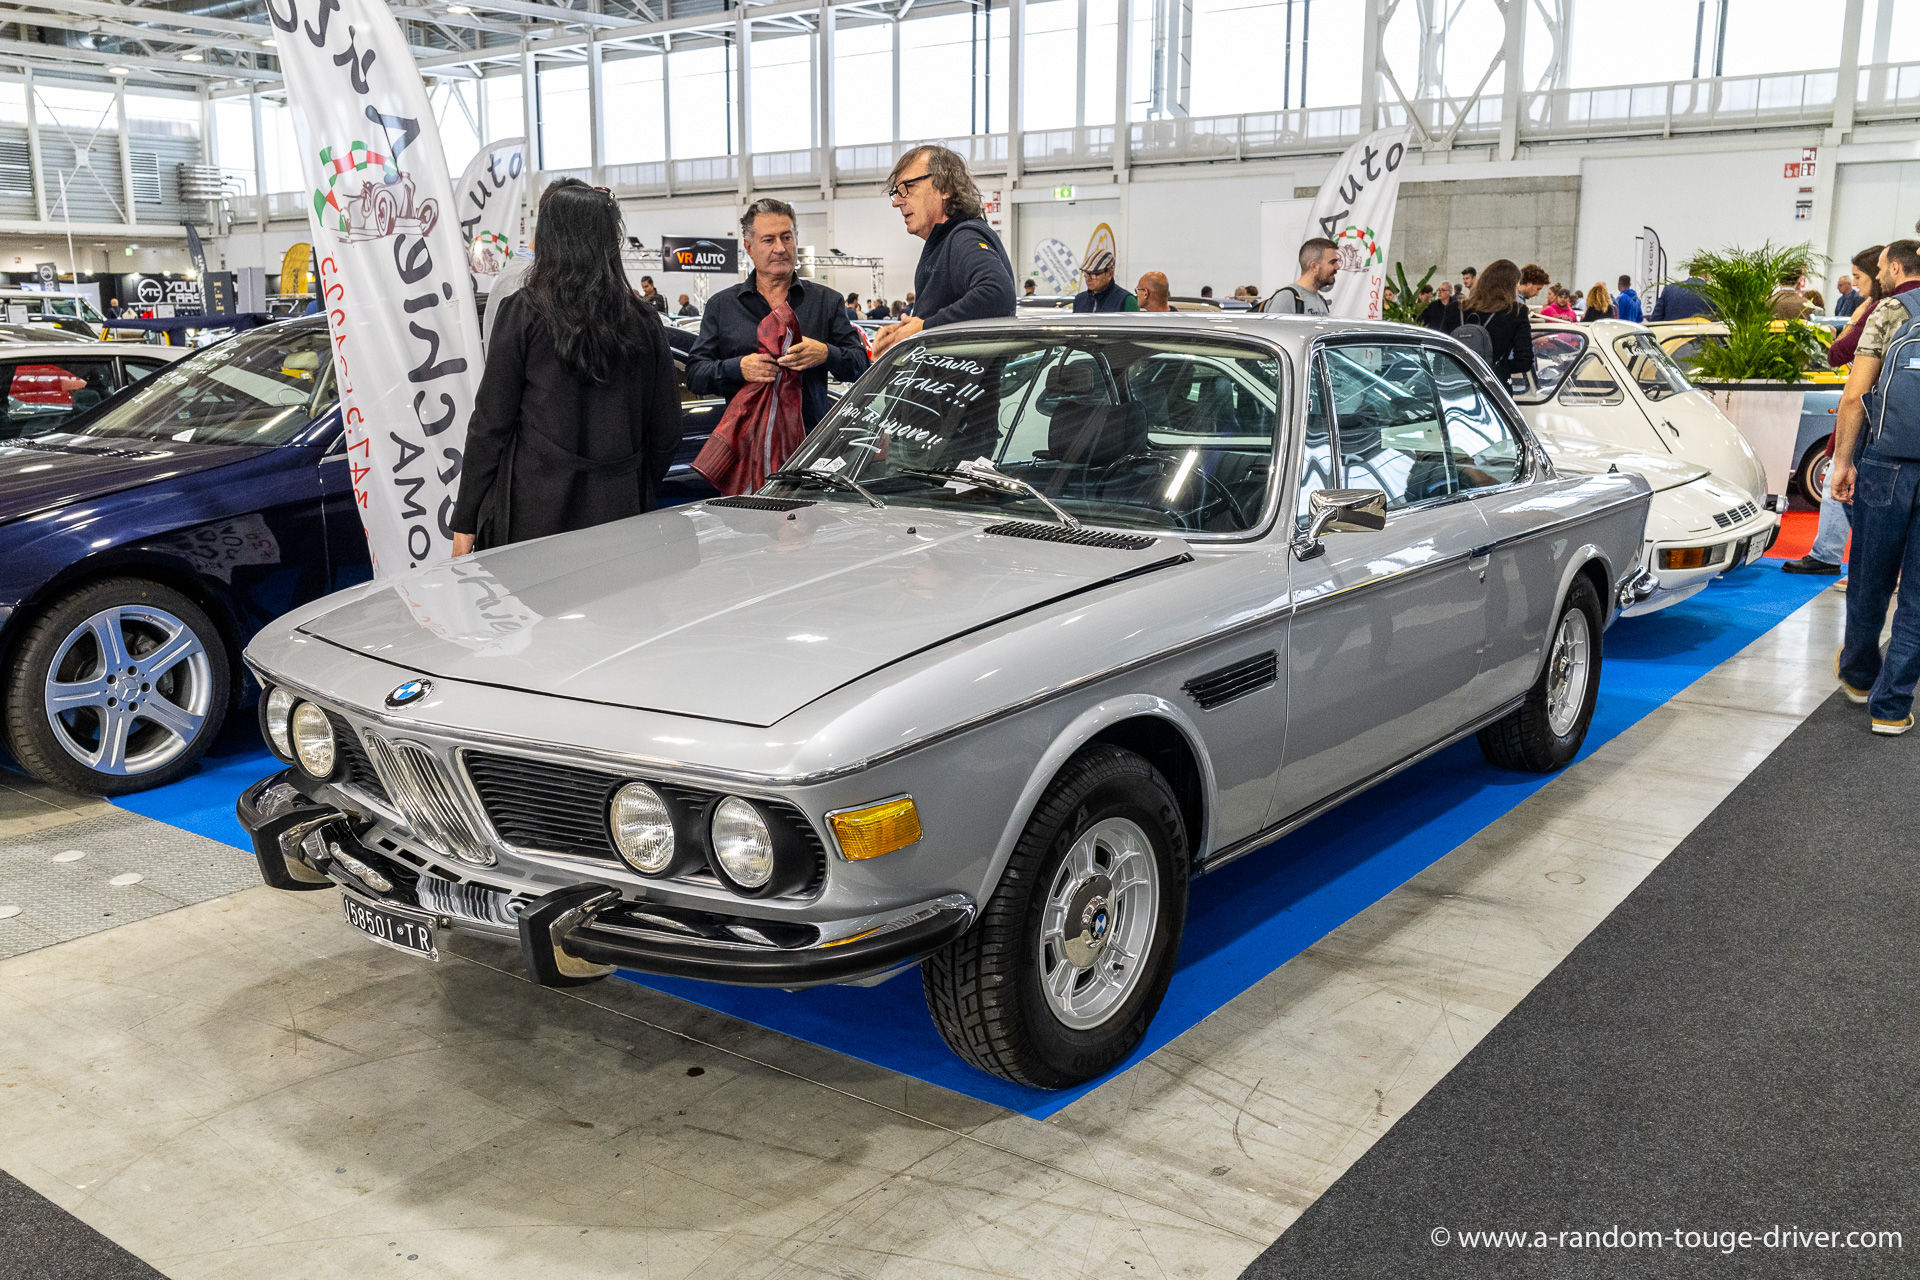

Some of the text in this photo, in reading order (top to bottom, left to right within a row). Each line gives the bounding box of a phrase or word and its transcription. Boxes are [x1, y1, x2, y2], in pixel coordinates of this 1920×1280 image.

[461, 152, 523, 244] Auto
[1320, 142, 1404, 239] Auto
[676, 252, 726, 265] VR AUTO
[404, 923, 430, 951] TR
